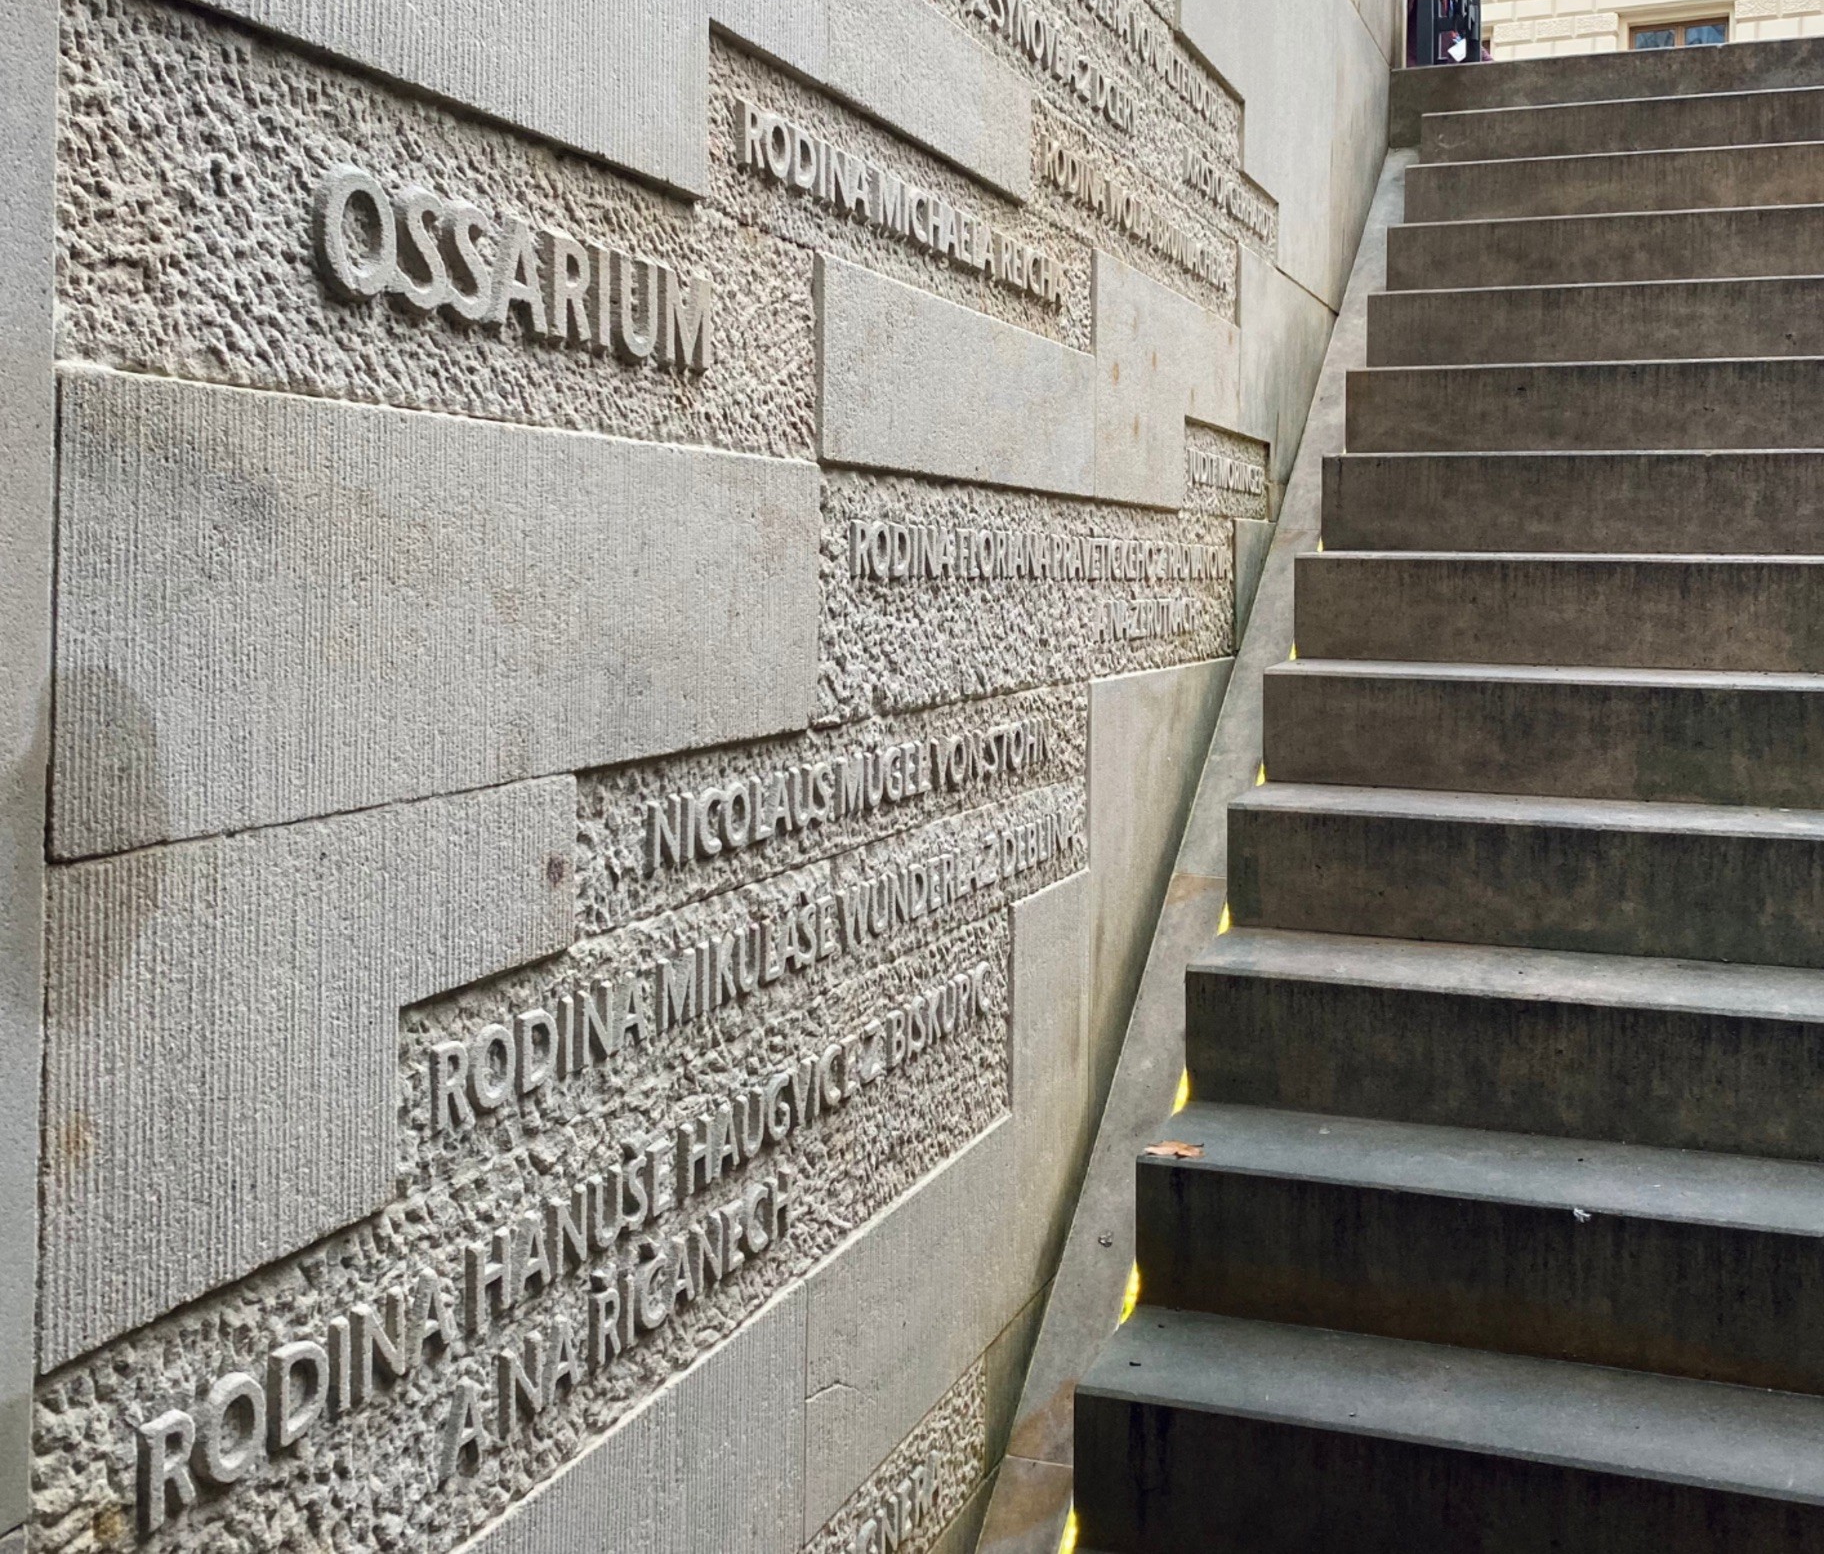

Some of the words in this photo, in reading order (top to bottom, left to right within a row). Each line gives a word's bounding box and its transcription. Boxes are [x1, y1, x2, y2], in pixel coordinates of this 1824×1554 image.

[312, 162, 713, 375] OSSARIUM
[735, 95, 872, 221] RODINA
[873, 169, 995, 281] MICHAELA
[643, 761, 835, 877] NICOLAUS
[429, 971, 648, 1134] RODINA
[136, 1266, 458, 1544] RODINA
[496, 1314, 580, 1440] NA
